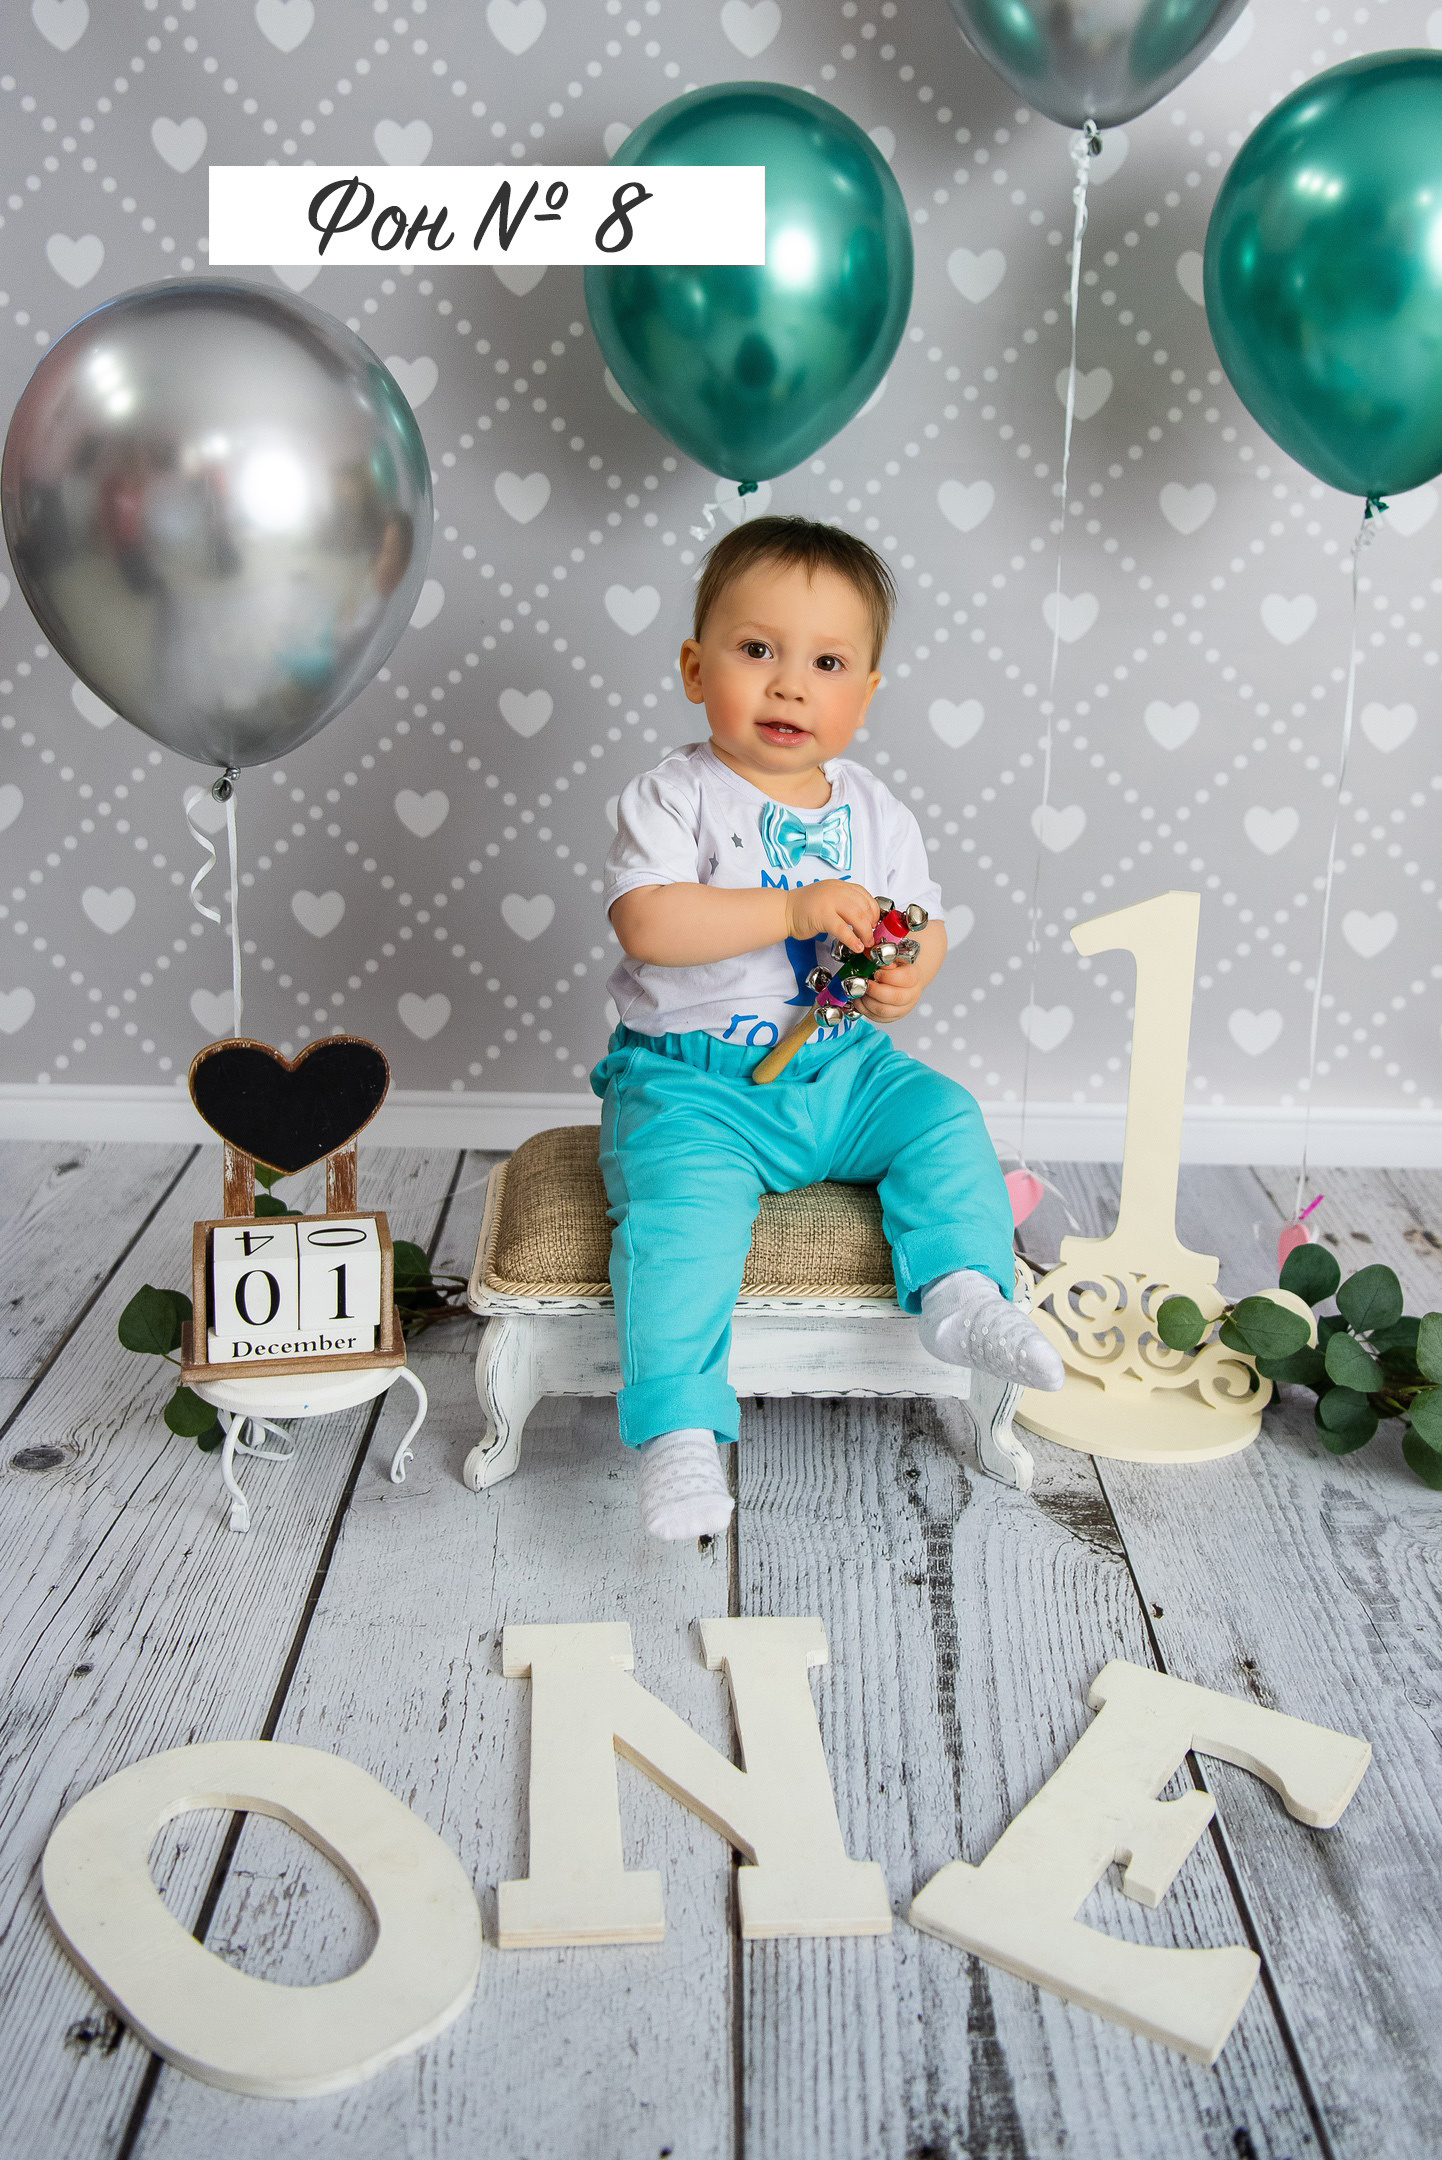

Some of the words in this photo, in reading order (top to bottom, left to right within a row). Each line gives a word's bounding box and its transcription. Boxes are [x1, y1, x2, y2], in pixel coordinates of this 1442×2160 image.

[1069, 889, 1220, 1284] 1
[232, 1334, 357, 1358] December
[40, 1614, 1373, 2098] ONE
